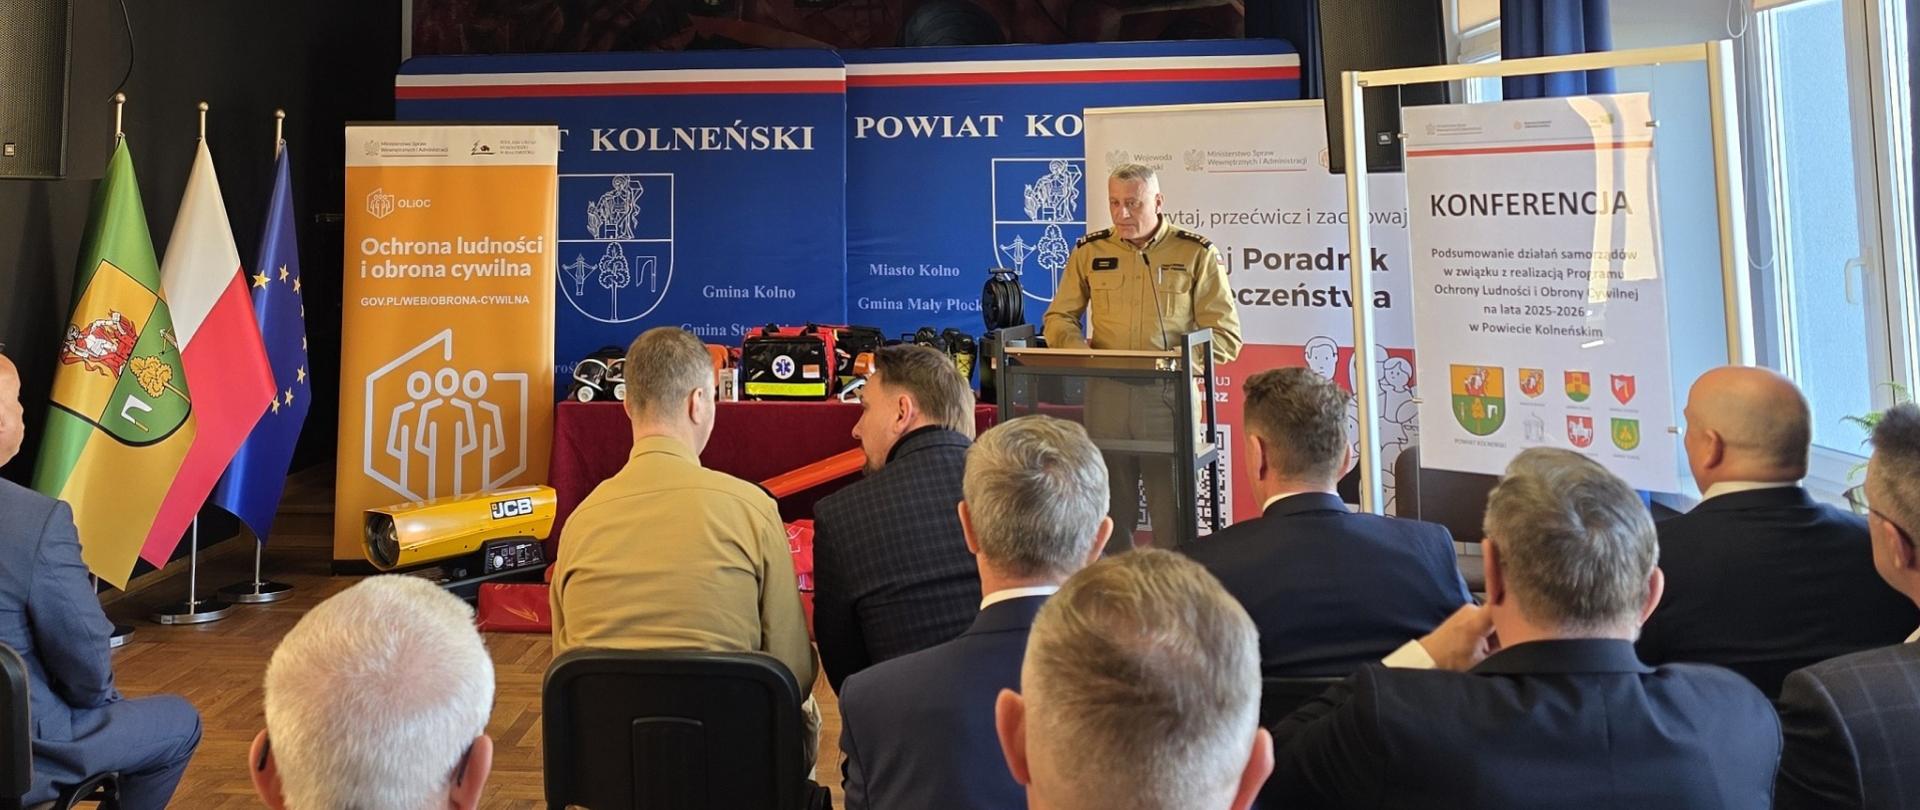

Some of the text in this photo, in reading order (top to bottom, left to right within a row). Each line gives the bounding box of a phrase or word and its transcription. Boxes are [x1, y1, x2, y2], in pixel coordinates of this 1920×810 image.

[855, 115, 1003, 139] POWIAT
[591, 119, 815, 152] KOLNEŃSKI
[1133, 153, 1173, 162] Wojewoda
[1207, 157, 1258, 167] Wewnętrznych
[1263, 156, 1308, 166] Administracji
[1253, 150, 1275, 158] Spraw
[1430, 190, 1634, 217] KONFERENCJA
[1211, 207, 1302, 229] przećwicz
[1307, 208, 1311, 225] i
[361, 236, 544, 255] Ochrona ludności
[1243, 247, 1389, 271] Poradnk
[1431, 248, 1638, 262] Podsumowanie działań samorządów
[360, 259, 532, 281] i obrona cywilna
[869, 263, 960, 277] Miasto Kolno
[1443, 267, 1624, 282] w związku z realizacją Programu
[702, 284, 796, 300] Gmina Kolno
[1434, 284, 1639, 301] Ochrony Ludności i Obrony Cywilnej
[360, 295, 530, 307] GOV.PL/WEB/OBRONA-CYWILNA
[858, 297, 983, 313] Gmina Mały Płock
[1484, 305, 1585, 318] na lata 2025-2026
[1469, 323, 1603, 338] w Powiecie Kolneńskim
[492, 498, 533, 519] JCB
